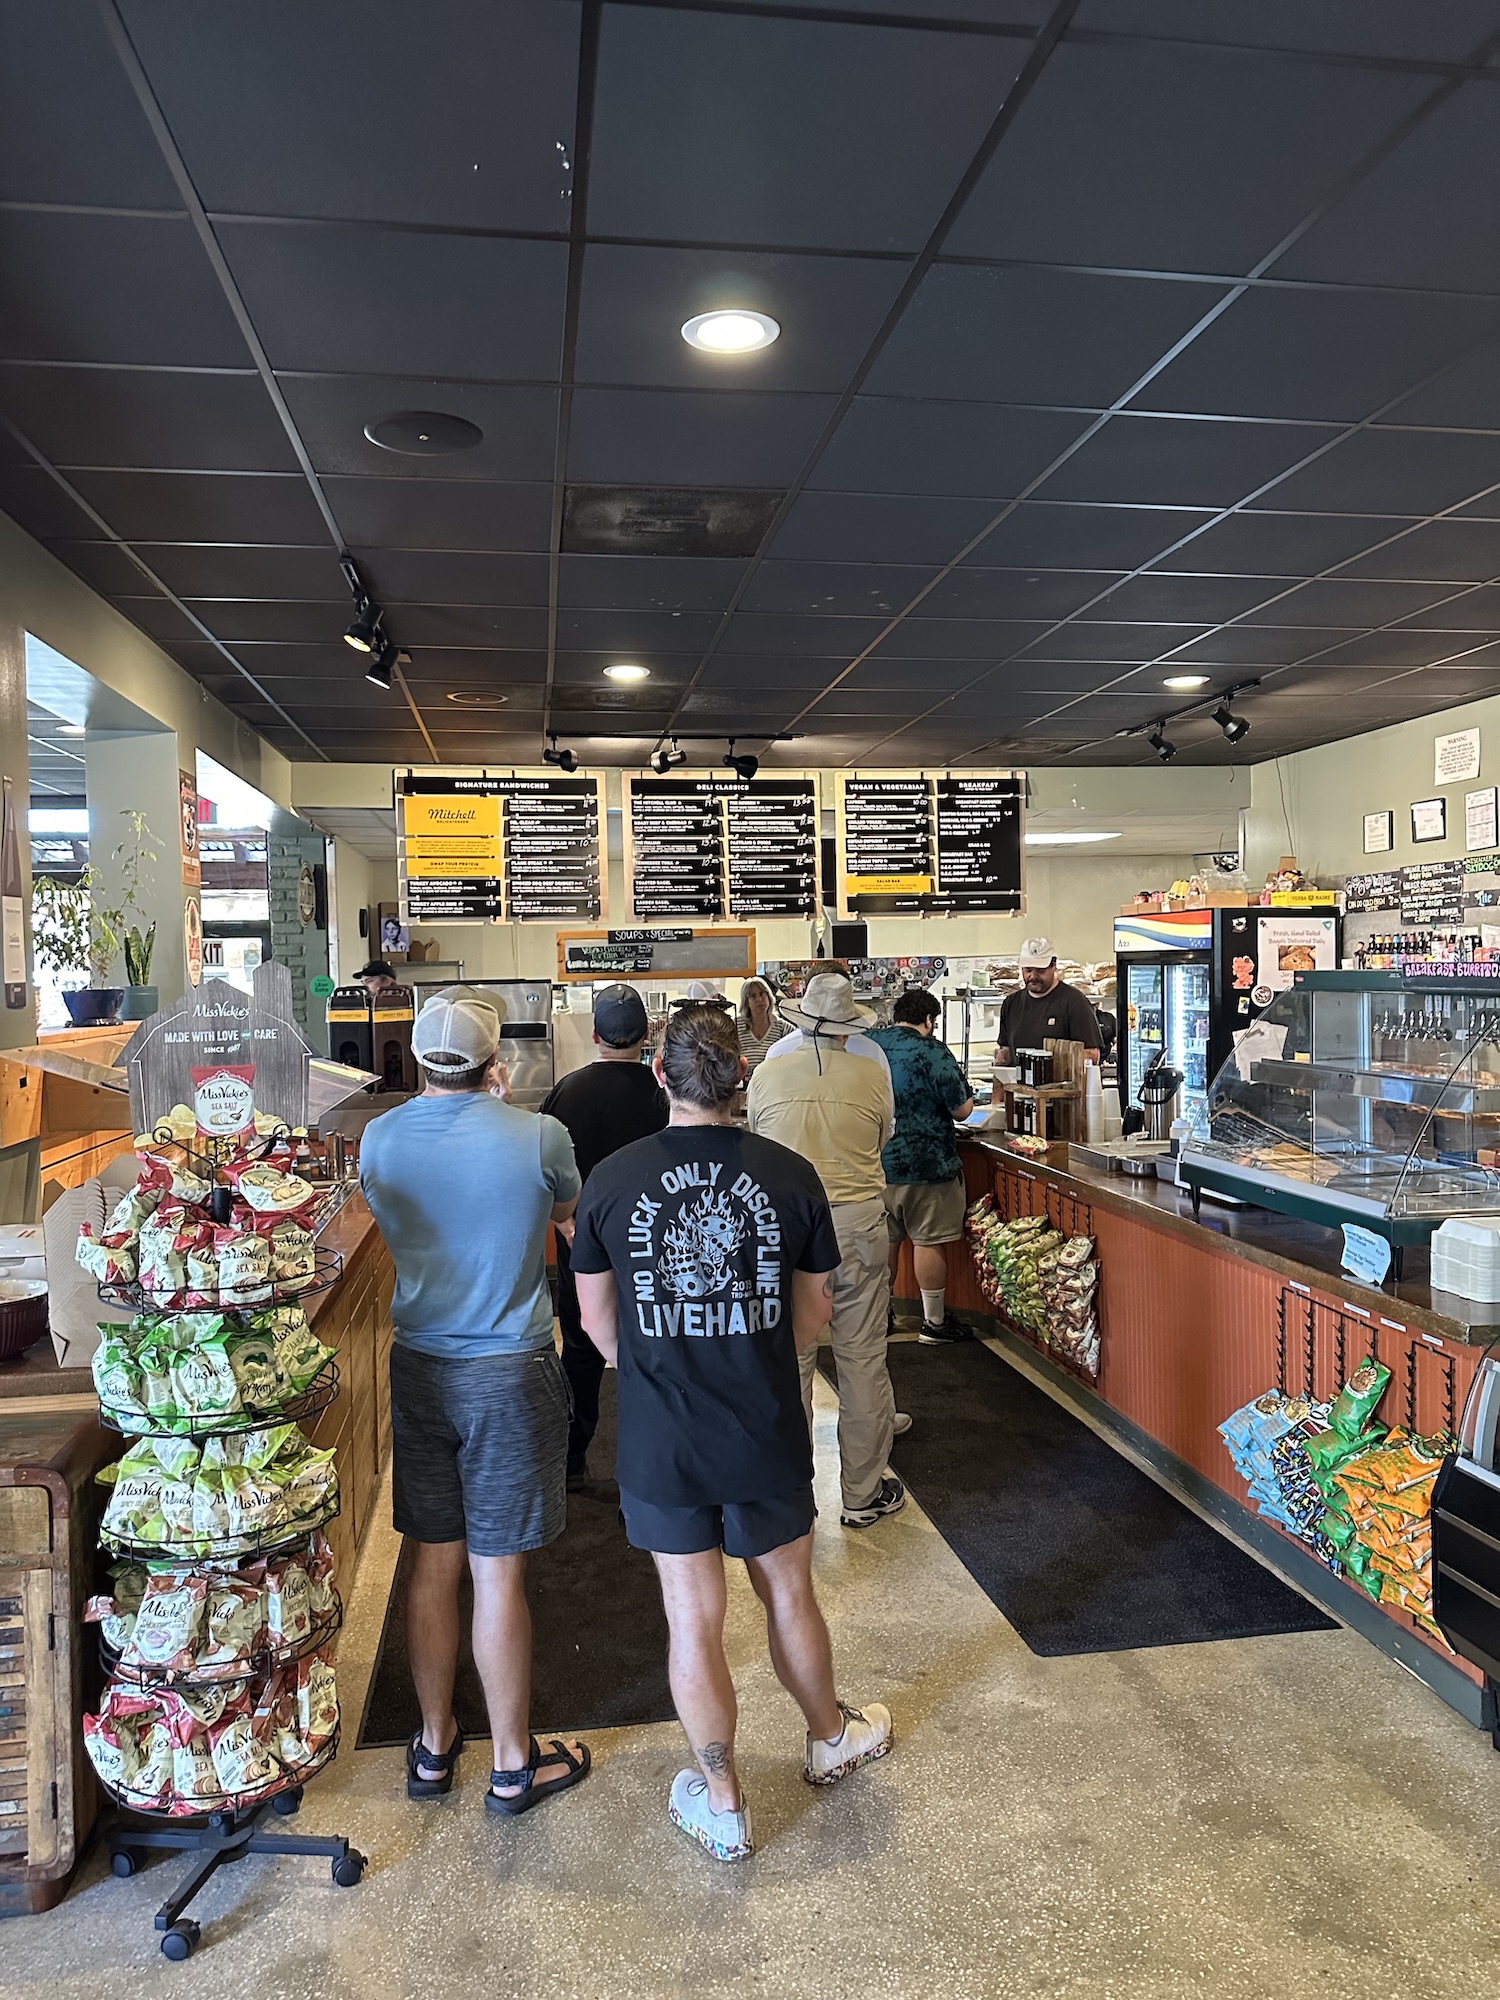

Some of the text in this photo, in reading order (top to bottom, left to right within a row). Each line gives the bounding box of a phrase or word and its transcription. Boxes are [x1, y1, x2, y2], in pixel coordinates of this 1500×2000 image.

[454, 781, 550, 790] SIGNATURE SANDWICHES
[428, 808, 476, 819] Mitchell
[615, 930, 644, 942] SOUPS
[1405, 962, 1455, 977] BREAKFAST
[164, 1032, 190, 1043] MADE
[191, 1030, 215, 1042] WITH
[216, 1029, 239, 1041] LOVE
[253, 1029, 277, 1040] CARE
[203, 1046, 225, 1054] SINCE
[211, 1101, 238, 1110] SEA SALT
[628, 1161, 781, 1302] NO LUCK ONLY DISCIPLINE
[235, 1264, 250, 1274] SEA
[731, 1279, 752, 1291] 2019
[636, 1297, 782, 1338] LIVEHARD
[194, 1761, 209, 1773] SEA
